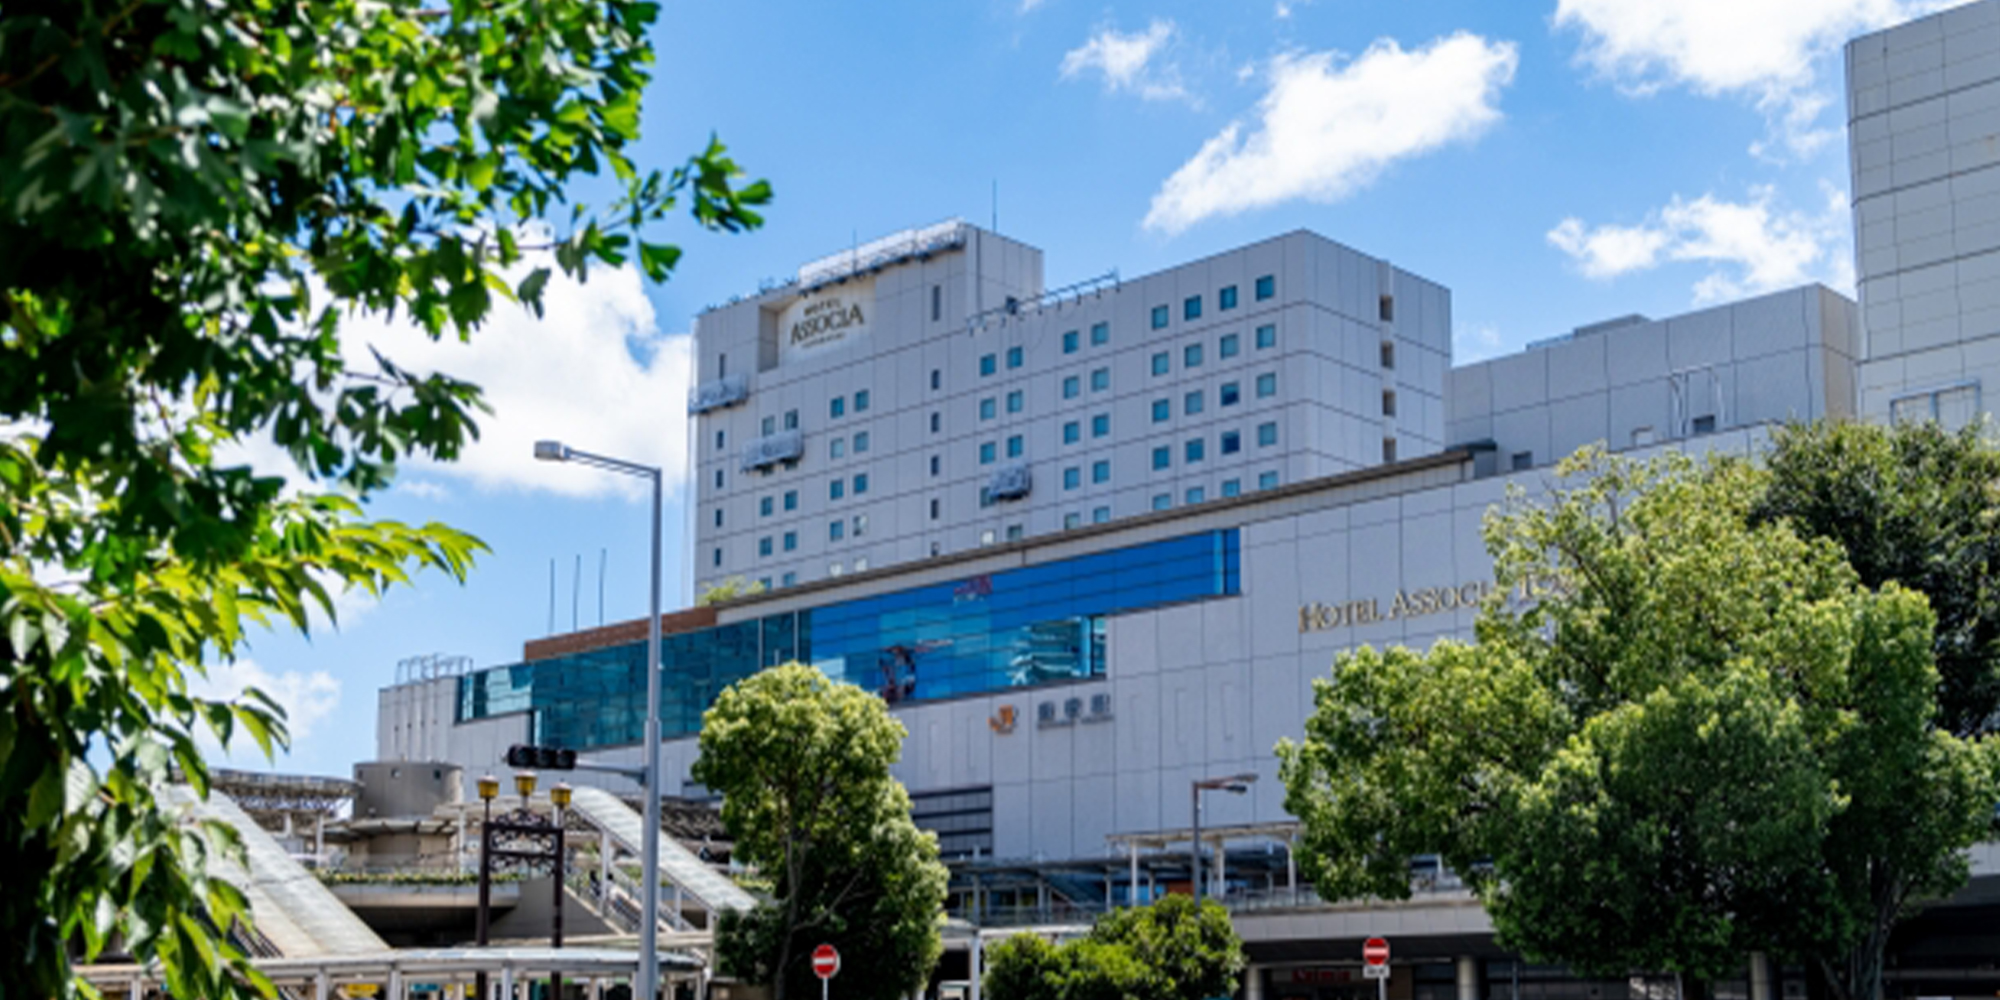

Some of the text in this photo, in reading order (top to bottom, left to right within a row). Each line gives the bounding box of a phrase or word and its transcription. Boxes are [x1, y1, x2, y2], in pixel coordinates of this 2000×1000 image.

[790, 303, 865, 345] ASSOCIA
[1298, 598, 1384, 634] HOTEL
[1388, 579, 1500, 619] ASSOCI
